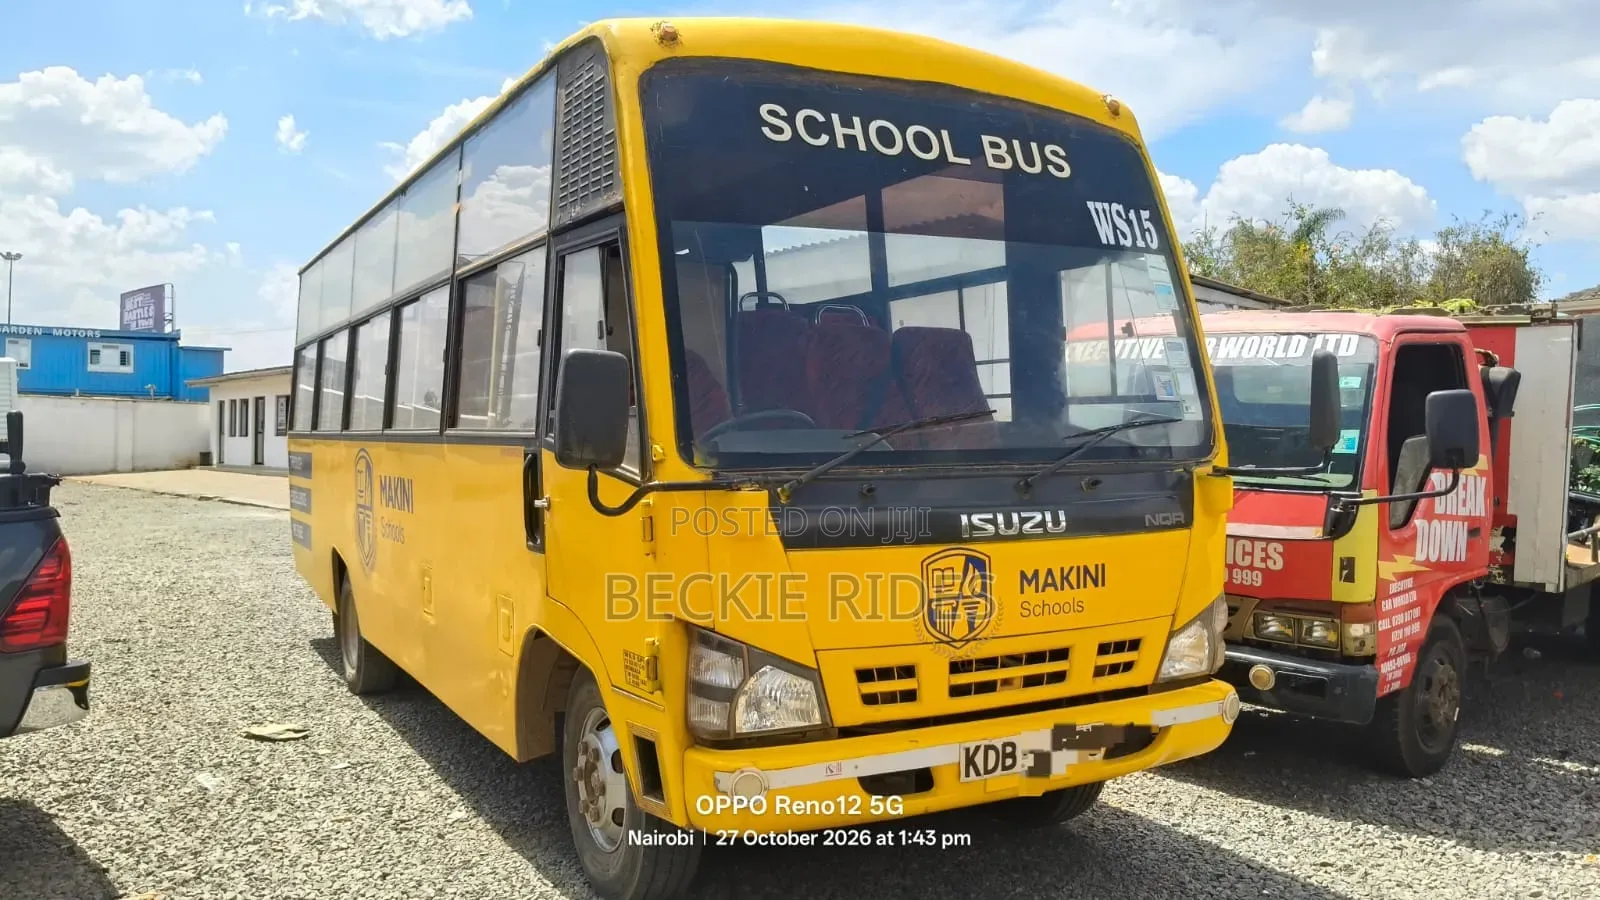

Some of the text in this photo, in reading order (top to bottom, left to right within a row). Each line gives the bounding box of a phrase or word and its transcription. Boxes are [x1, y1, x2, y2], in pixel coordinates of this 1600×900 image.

[759, 103, 1072, 179] SCHOOL BUS
[1086, 200, 1159, 250] WS15
[52, 327, 101, 338] MOTORS
[1216, 334, 1309, 359] WORLD
[379, 474, 414, 515] MAKINI
[1430, 471, 1487, 517] BREAK
[960, 509, 1067, 538] ISUZU
[1144, 511, 1186, 527] NQR
[1413, 518, 1468, 562] DOWN
[1019, 563, 1107, 595] MAKINI
[1231, 568, 1263, 587] 999
[1019, 597, 1086, 618] Schools
[963, 741, 1018, 778] KDB
